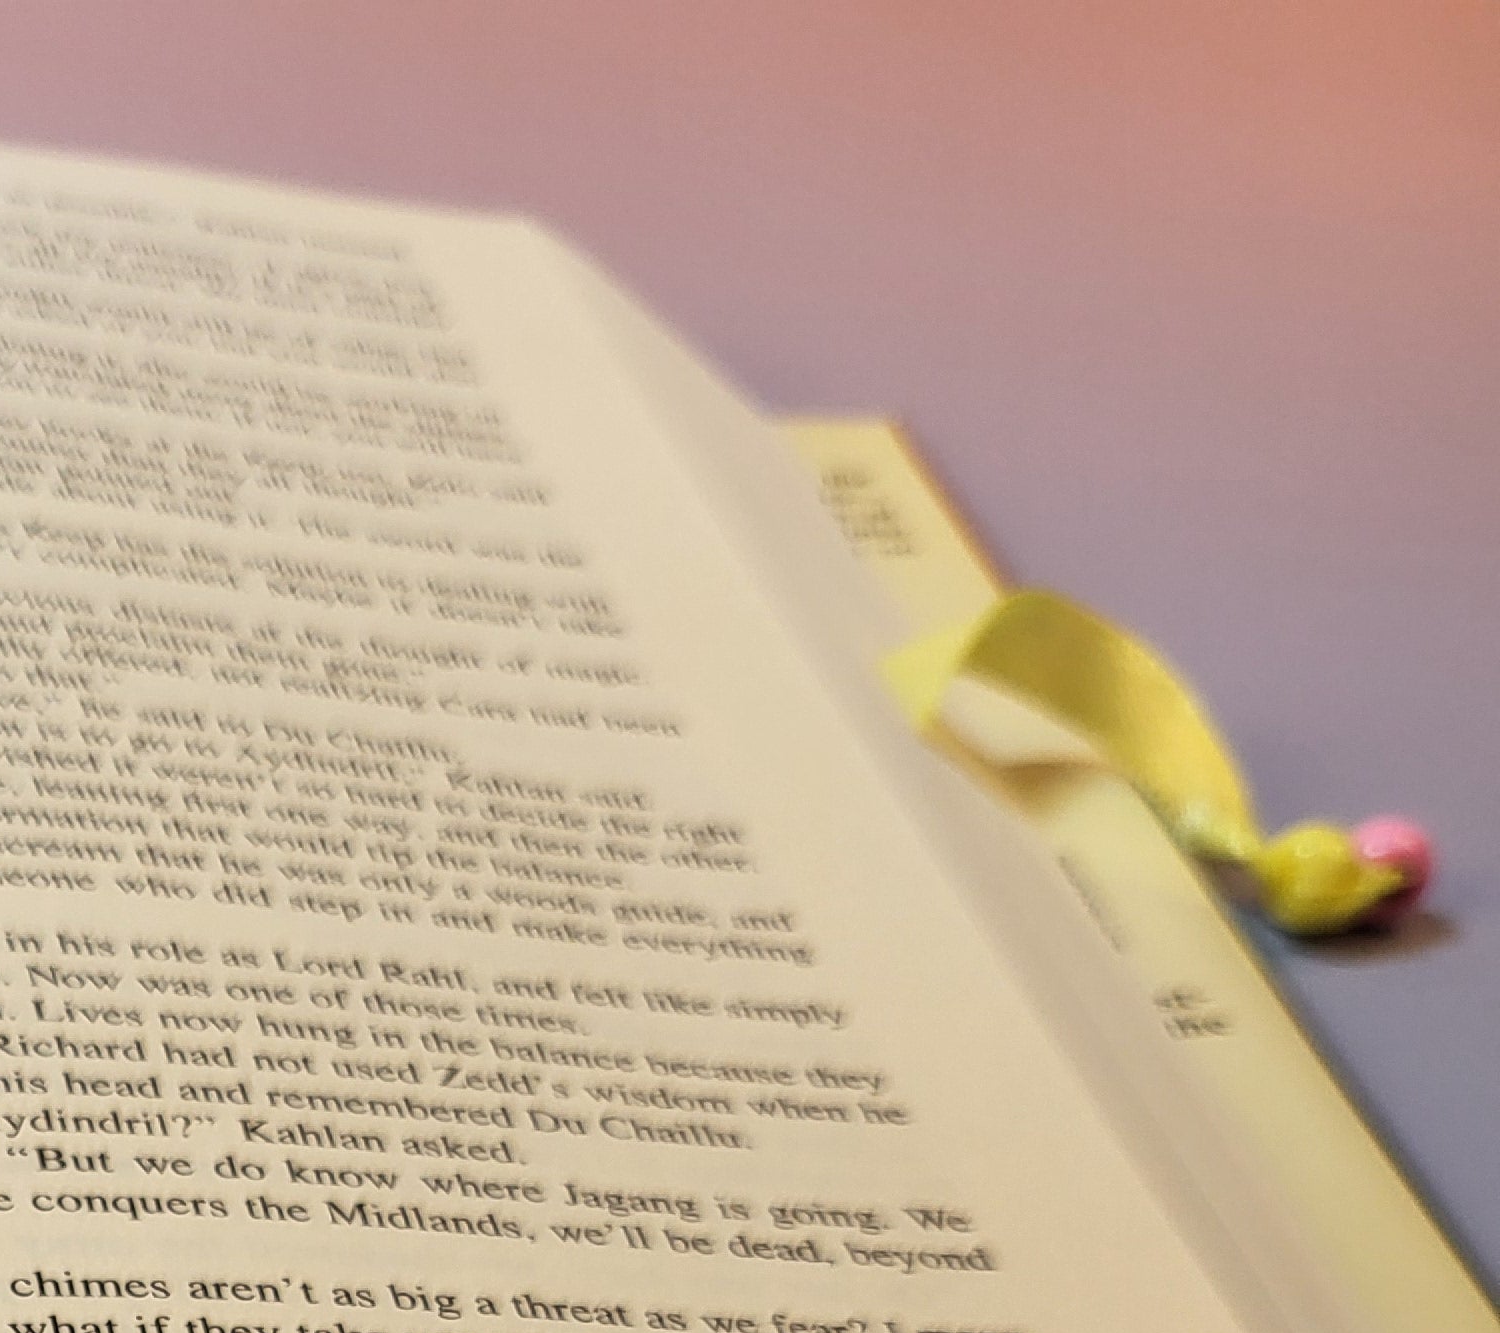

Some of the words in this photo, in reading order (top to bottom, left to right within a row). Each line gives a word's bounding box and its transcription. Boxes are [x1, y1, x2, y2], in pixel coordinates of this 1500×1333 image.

[6, 1145, 113, 1174] “But
[132, 1154, 194, 1178] we
[213, 1153, 267, 1181] do
[283, 1157, 399, 1191] know
[420, 1171, 545, 1205] where
[563, 1180, 702, 1224] Jagang
[713, 1195, 751, 1221] is
[767, 1201, 890, 1237] going.
[901, 1206, 972, 1235] We
[30, 1192, 230, 1223] conquers
[244, 1193, 311, 1224] the
[324, 1199, 537, 1243] Midlands,
[549, 1210, 653, 1252] we’ll
[661, 1217, 716, 1257] be
[727, 1224, 837, 1267] dead,
[842, 1229, 998, 1276] beyond
[9, 1268, 172, 1300] chimes
[187, 1275, 319, 1306] aren’t
[331, 1286, 377, 1309] as
[386, 1281, 463, 1322] big
[474, 1295, 501, 1318] a
[510, 1291, 634, 1329] threat
[644, 1310, 689, 1332] as
